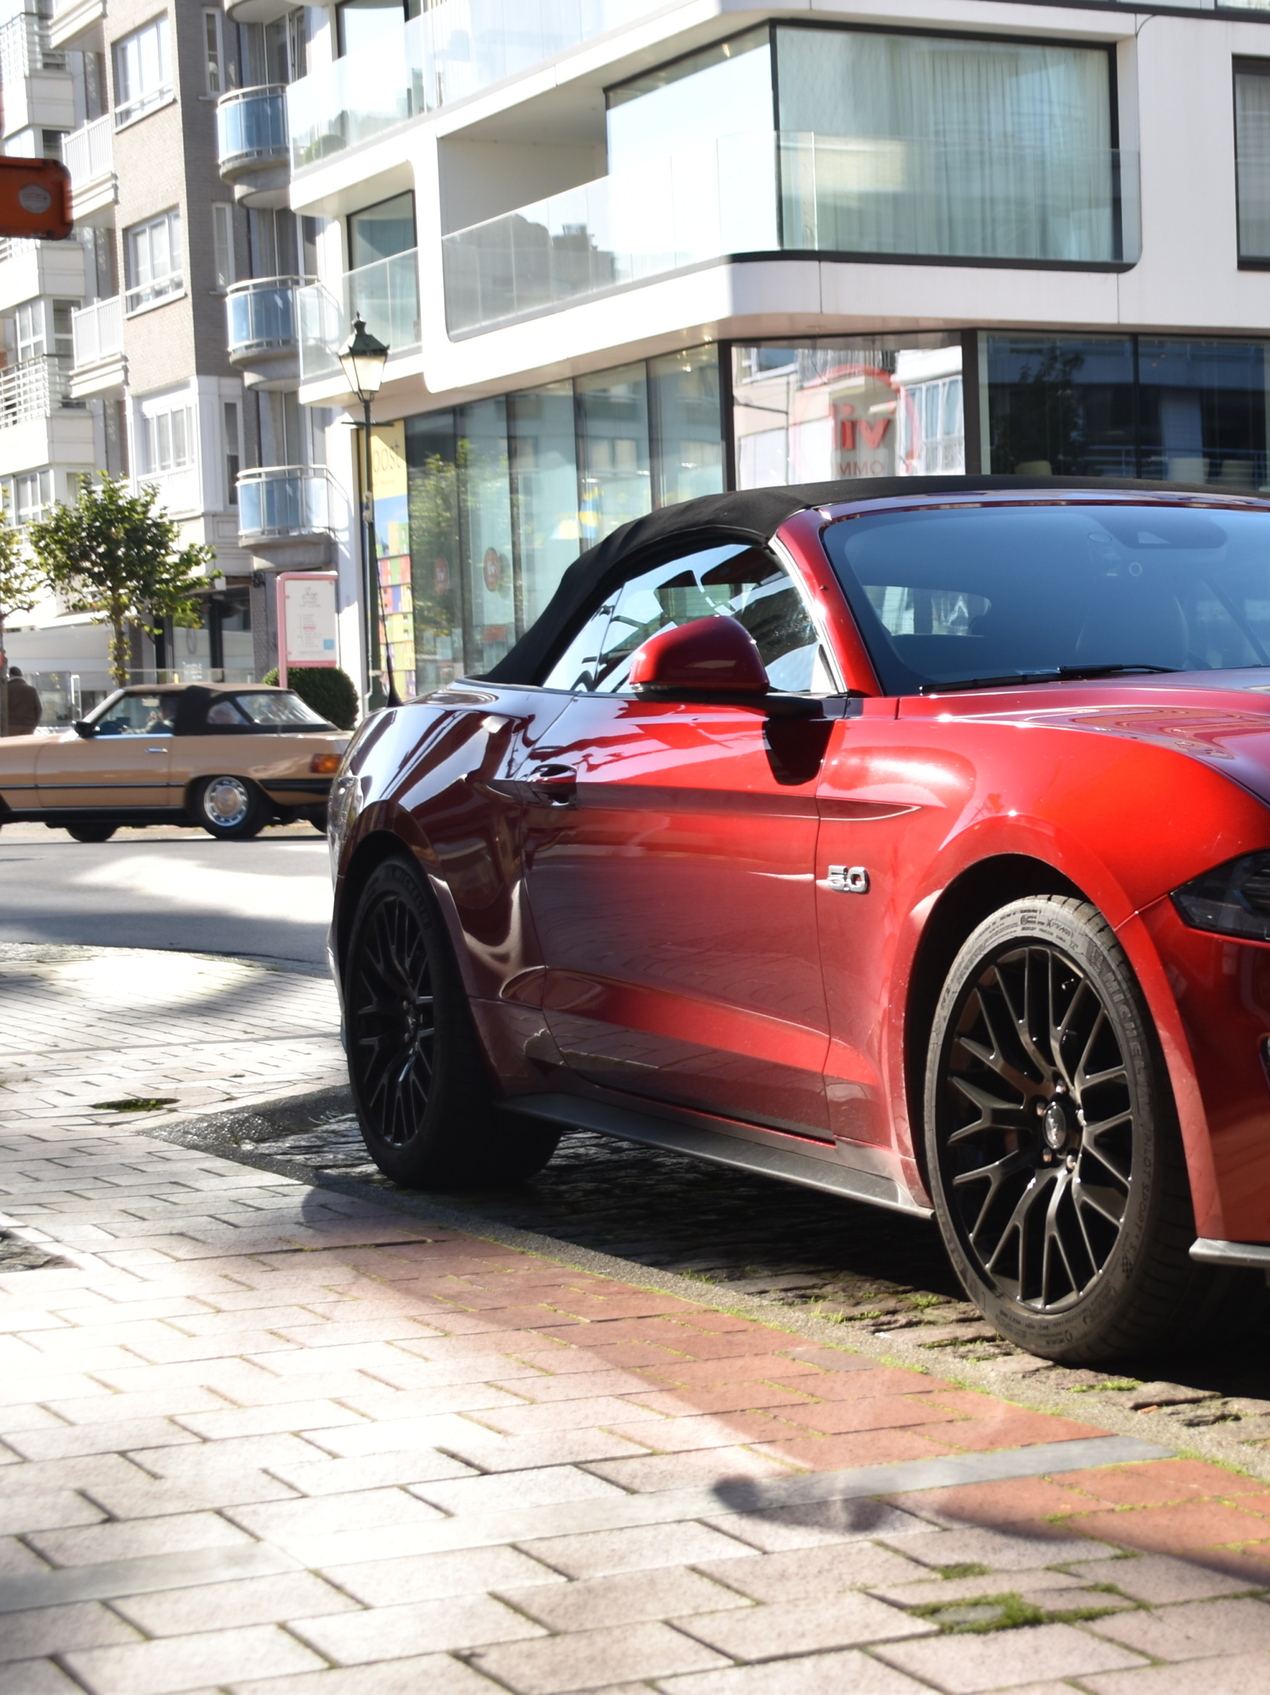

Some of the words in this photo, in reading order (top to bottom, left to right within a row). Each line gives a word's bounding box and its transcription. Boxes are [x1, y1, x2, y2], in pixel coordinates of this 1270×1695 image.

[827, 865, 869, 893] 5.0
[1103, 971, 1150, 1115] MICHELIN
[1143, 1132, 1152, 1176] PILOT
[1135, 1181, 1150, 1230] SPORT
